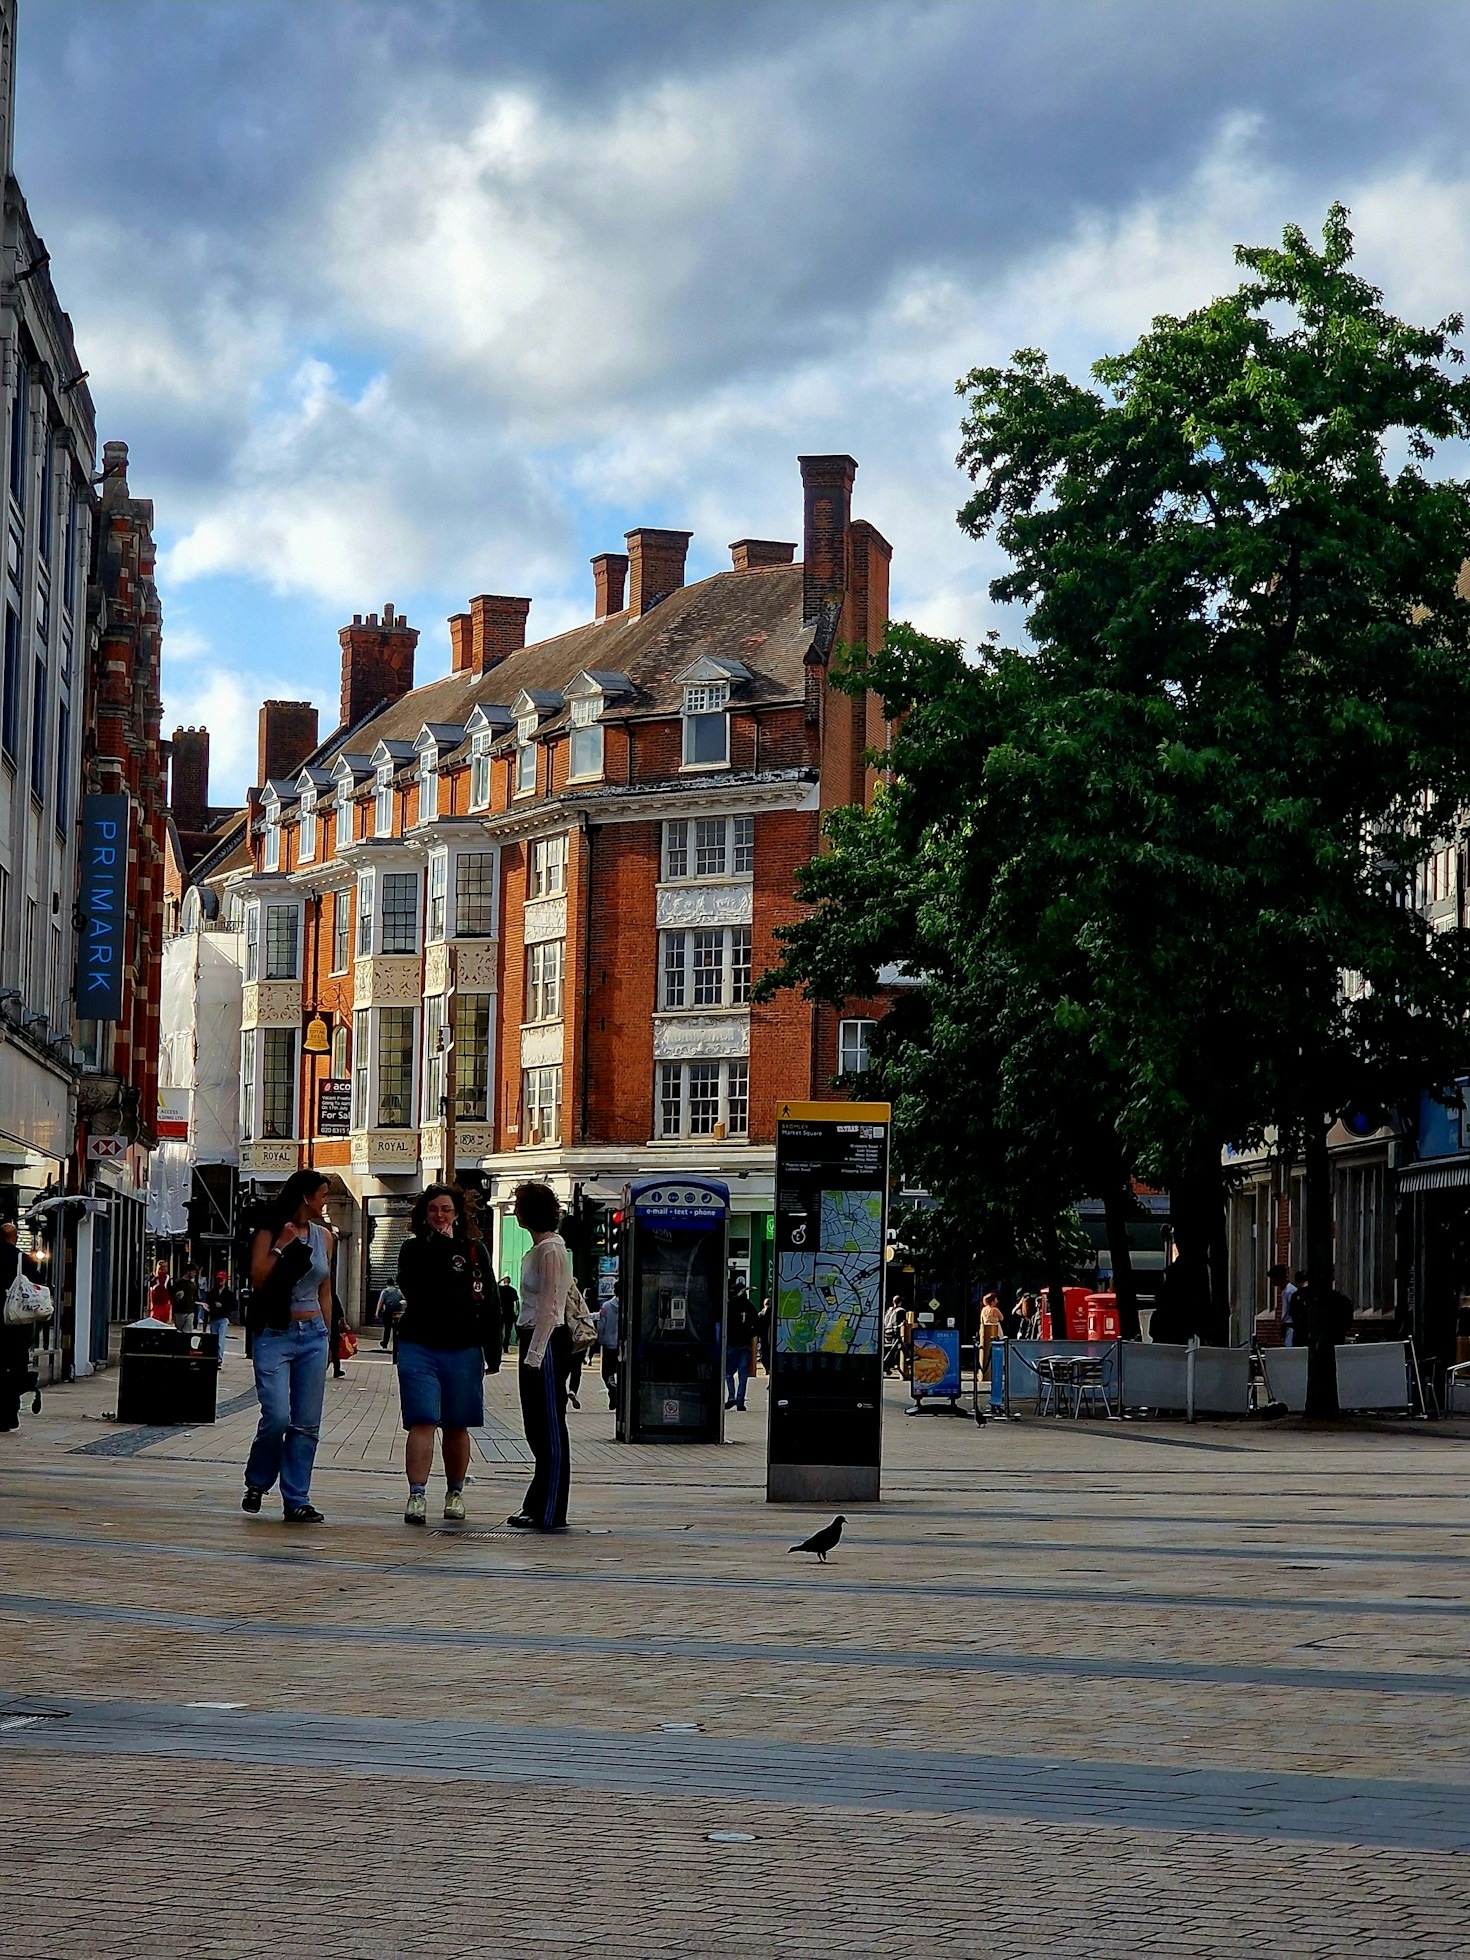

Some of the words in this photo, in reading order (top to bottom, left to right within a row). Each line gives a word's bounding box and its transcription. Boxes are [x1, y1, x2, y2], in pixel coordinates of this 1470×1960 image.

[87, 821, 117, 991] PRIMARK
[321, 1111, 336, 1119] For
[377, 1141, 409, 1152] ROYAL
[263, 1152, 290, 1161] ROYAL
[673, 1208, 688, 1216] text
[693, 1209, 716, 1217] phone
